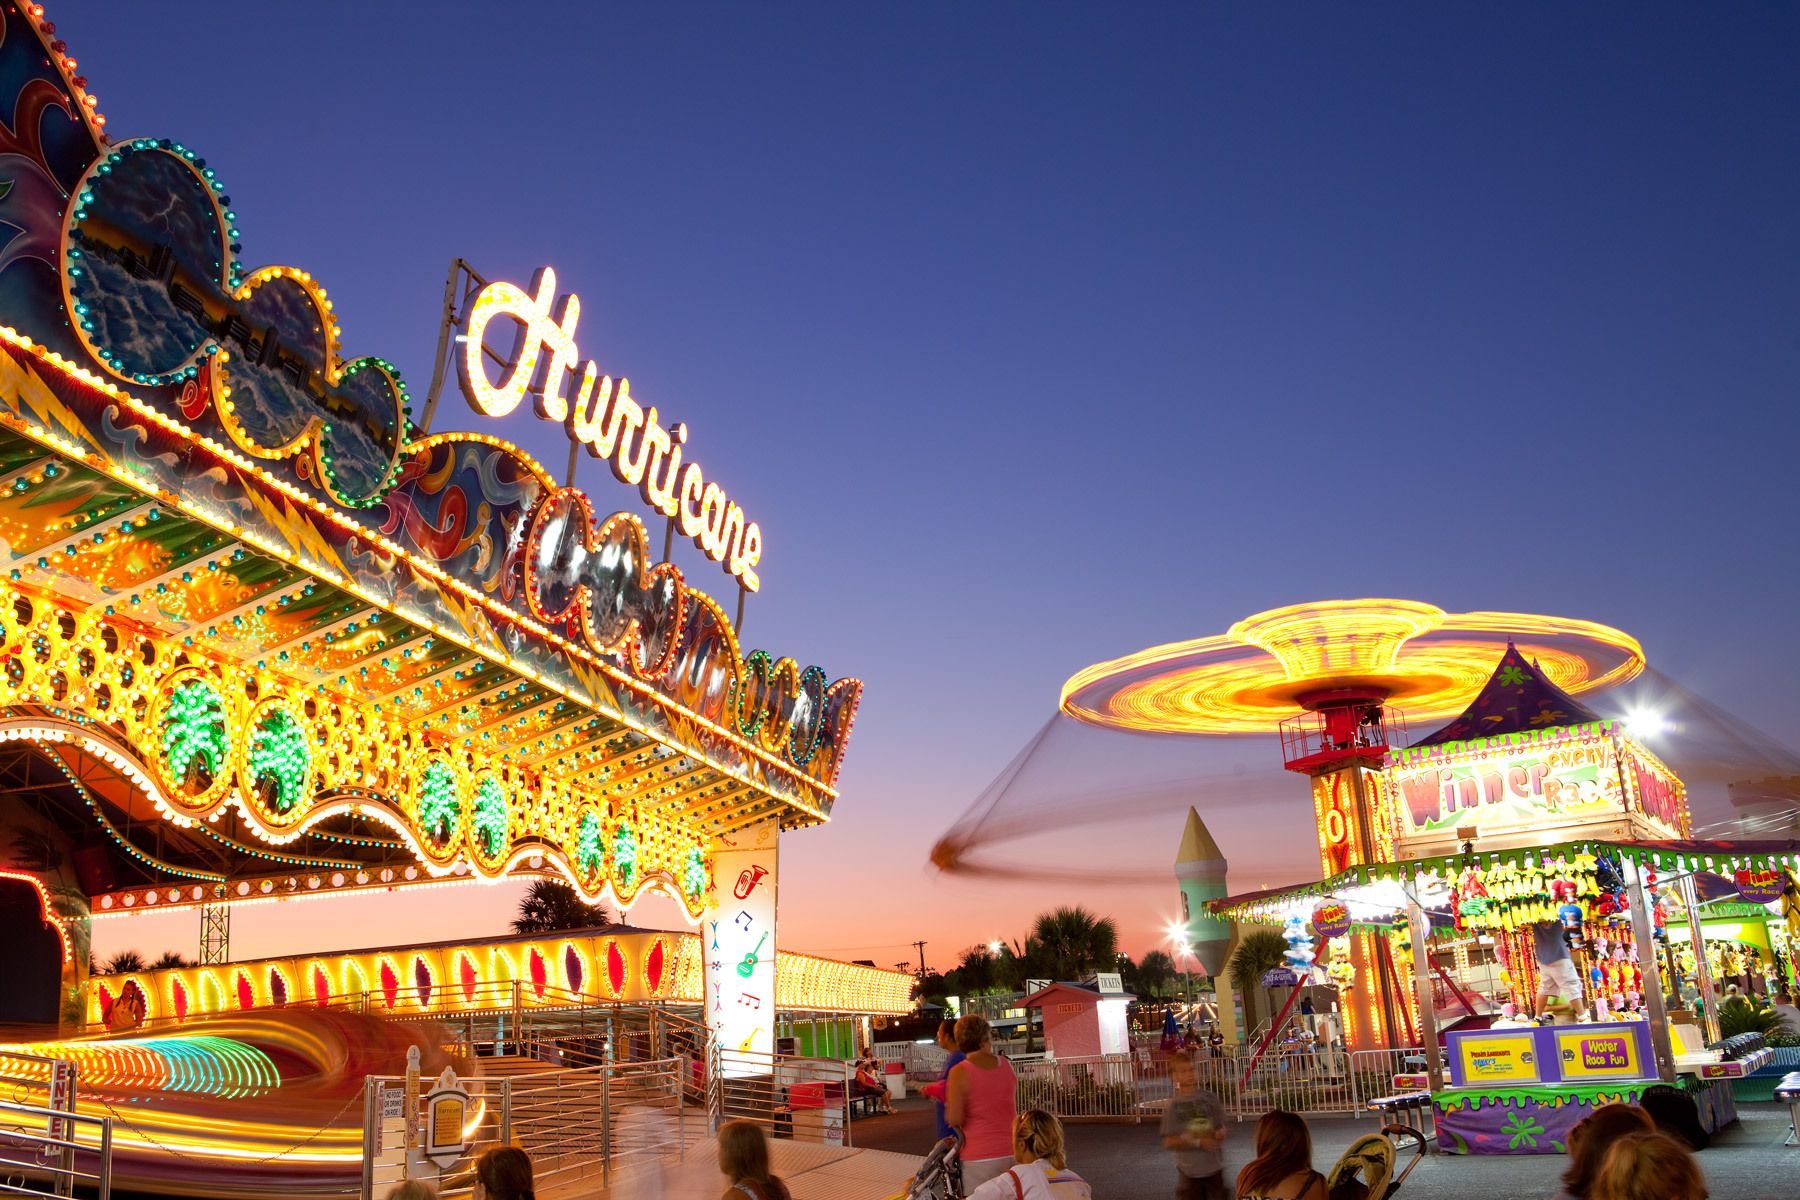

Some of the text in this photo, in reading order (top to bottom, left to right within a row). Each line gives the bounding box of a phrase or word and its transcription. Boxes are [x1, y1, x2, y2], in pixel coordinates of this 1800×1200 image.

[464, 266, 763, 594] Hurricane
[1550, 745, 1609, 769] every
[1400, 762, 1550, 827] Winner
[1544, 777, 1617, 808] Race
[1100, 977, 1121, 989] TICKETS
[1059, 1003, 1082, 1013] TICKETS
[1588, 1040, 1618, 1054] Water
[1585, 1053, 1625, 1066] Race Fun
